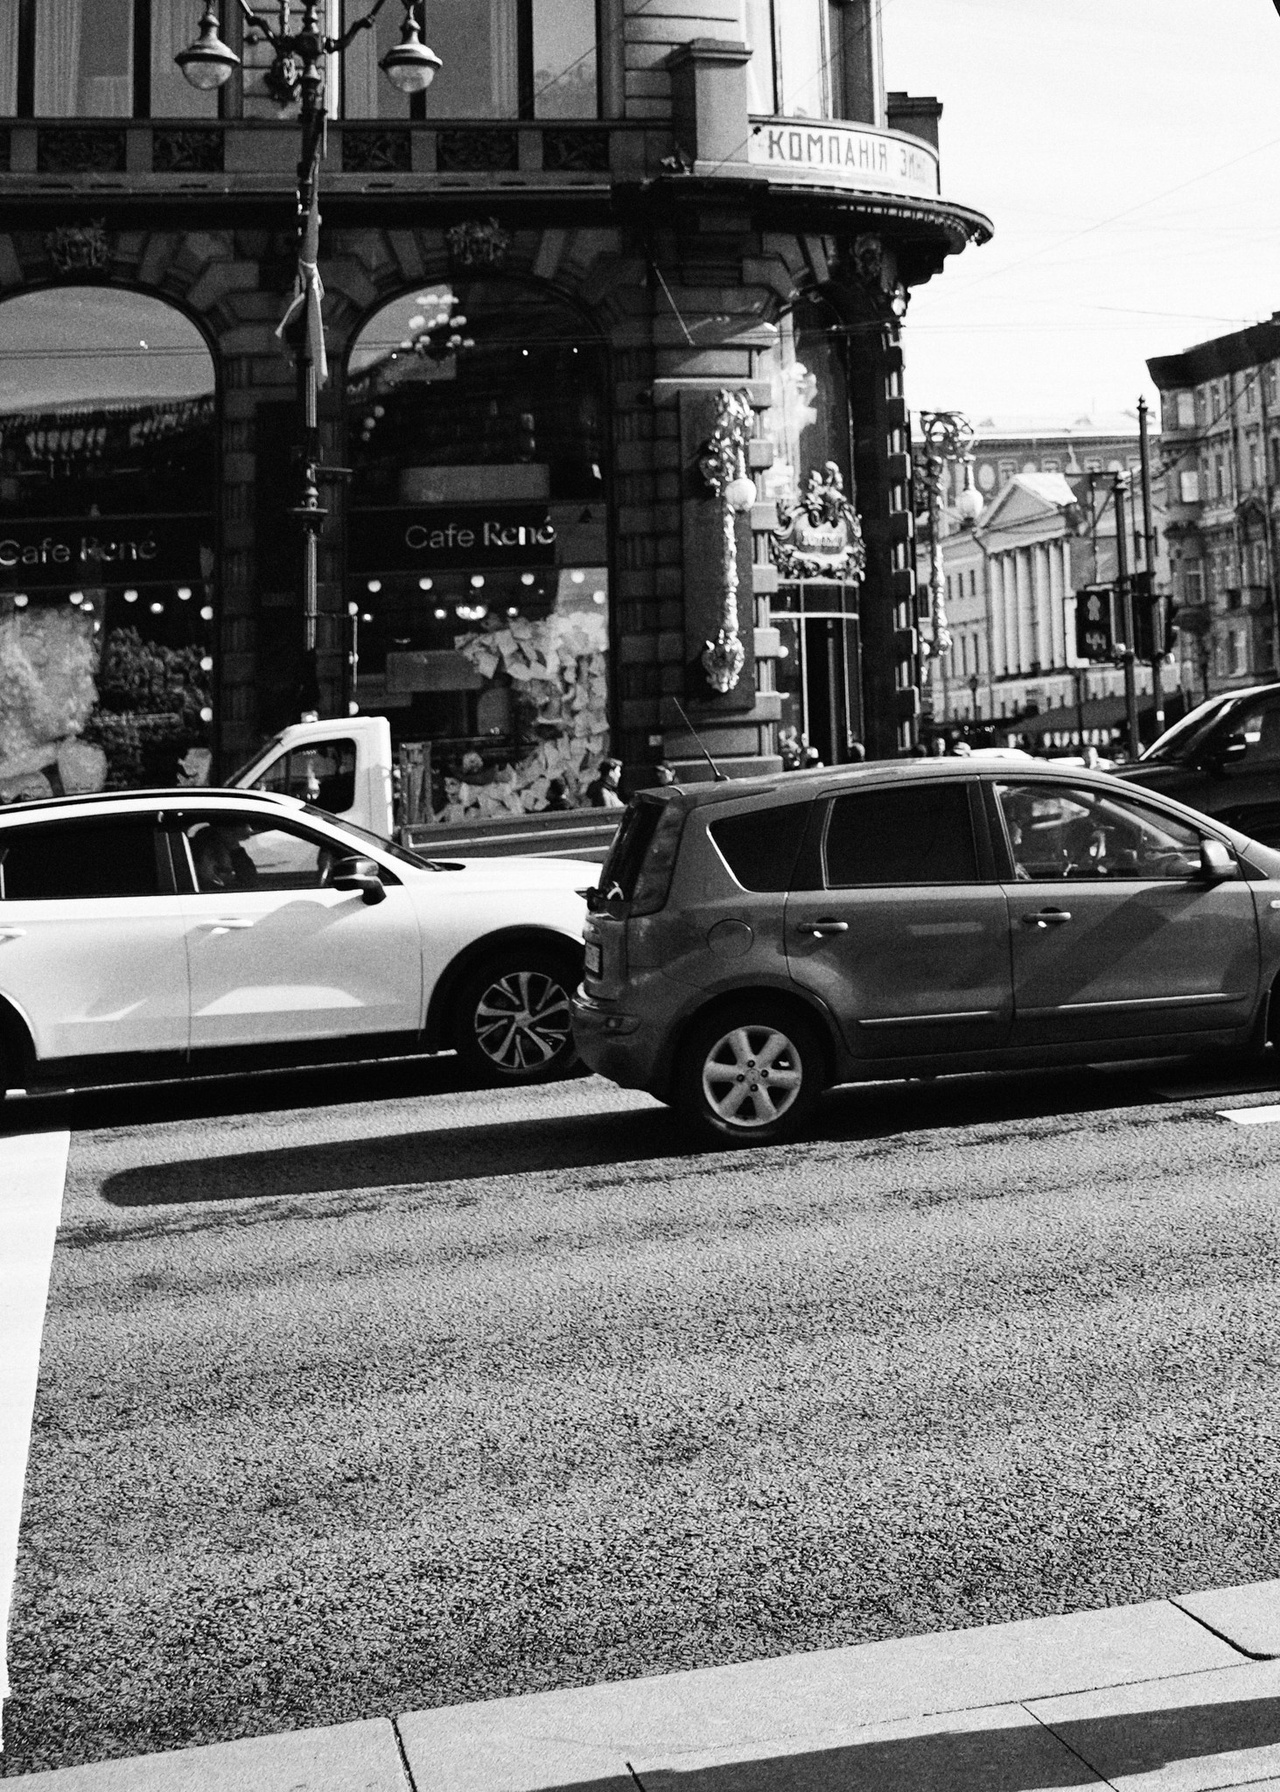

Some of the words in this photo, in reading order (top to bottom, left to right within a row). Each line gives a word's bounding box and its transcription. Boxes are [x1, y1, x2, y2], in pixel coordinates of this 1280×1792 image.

[768, 129, 888, 173] КОМПАНІЯ
[405, 523, 475, 549] Cafe
[0, 537, 71, 566] Cafe
